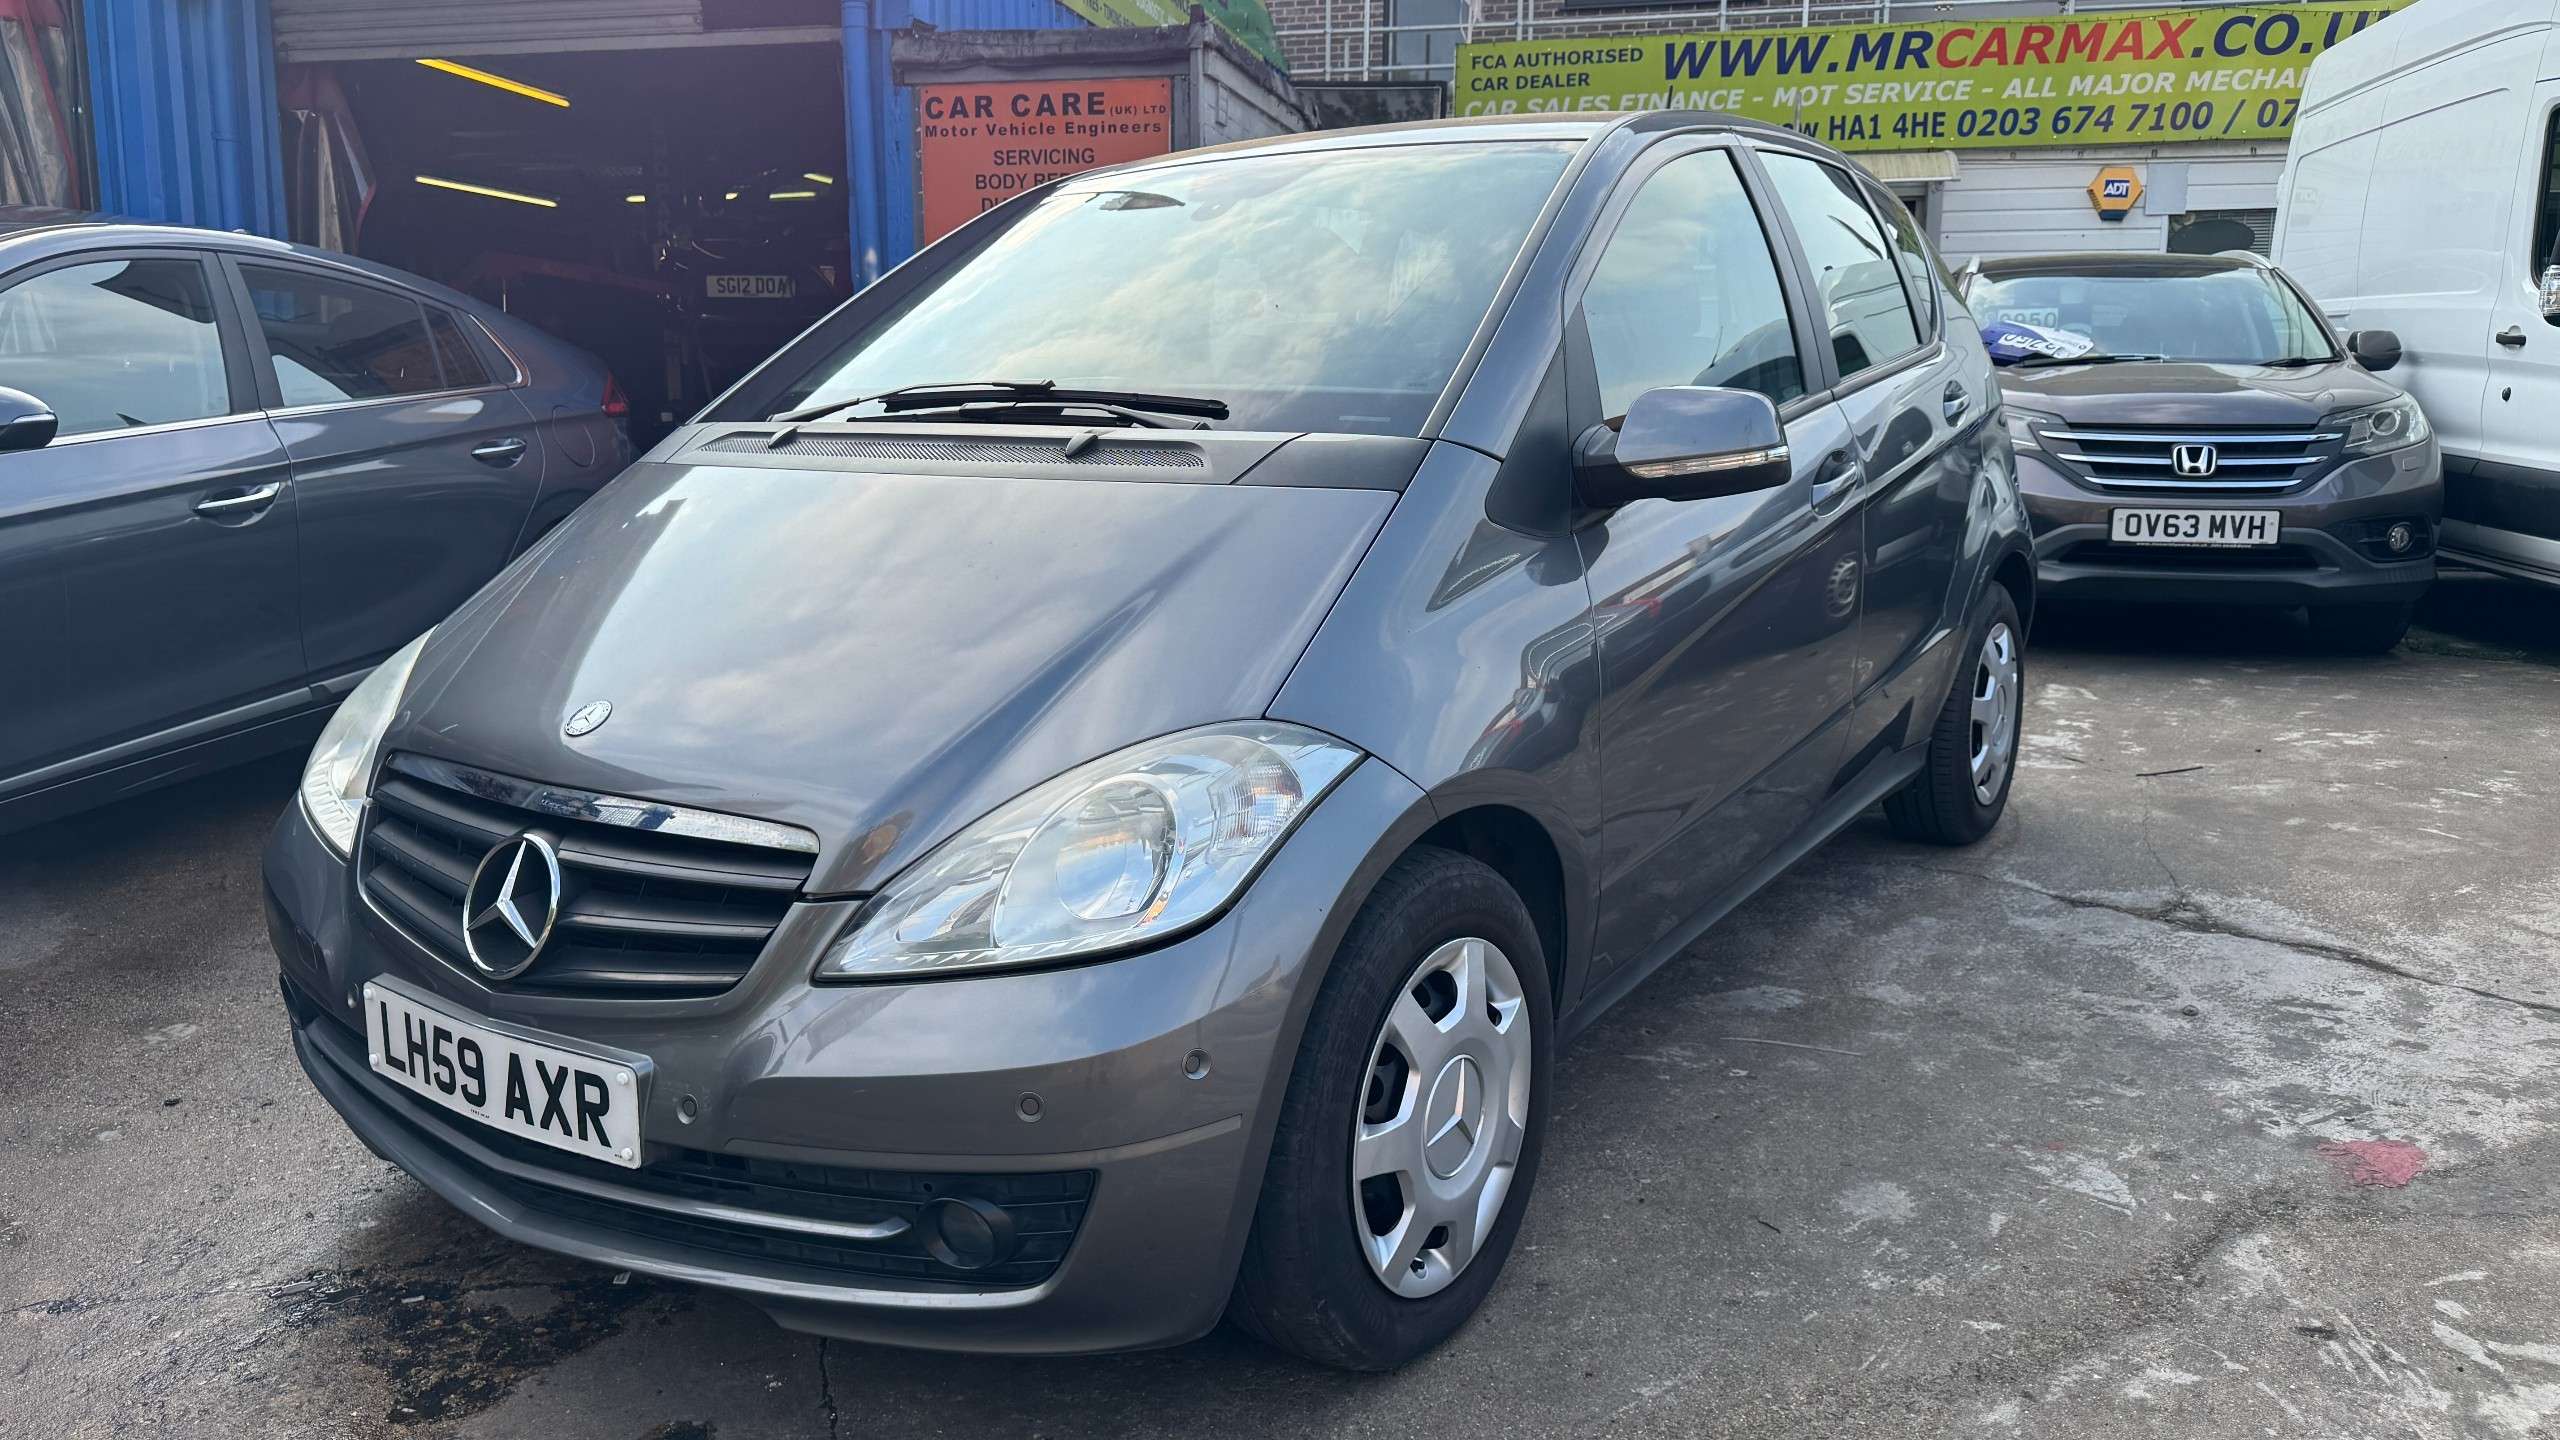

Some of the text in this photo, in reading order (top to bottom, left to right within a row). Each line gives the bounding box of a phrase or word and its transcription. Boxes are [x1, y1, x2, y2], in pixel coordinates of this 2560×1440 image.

[1665, 12, 2391, 80] WWW.MRCARMAX.CO.U
[1472, 48, 1644, 70] FCA AUTHORISED
[1471, 72, 1590, 92] CAR DEALER
[925, 92, 1167, 119] CAR CARE (UK) LTD
[1464, 100, 1518, 118] CAR
[1527, 95, 1610, 114] SALES
[1619, 88, 1745, 113] FINANCE
[1772, 85, 1839, 108] MOT
[1844, 79, 1974, 105] SERVICE
[2001, 76, 2057, 99] ALL
[2067, 72, 2176, 96] MAJOR
[925, 120, 1161, 138] Motor Vehicle Engineers
[1828, 114, 1882, 141] HA1
[1893, 111, 1947, 139] 4HE
[1957, 107, 2041, 137] 0203
[2051, 104, 2116, 134] 674
[2126, 101, 2214, 132] 7100
[993, 148, 1095, 166] SERVICING
[976, 173, 1026, 189] BODY
[2104, 181, 2130, 196] ADT
[2125, 513, 2266, 540] OV63 MVH
[380, 1000, 612, 1148] LH59 AXR
